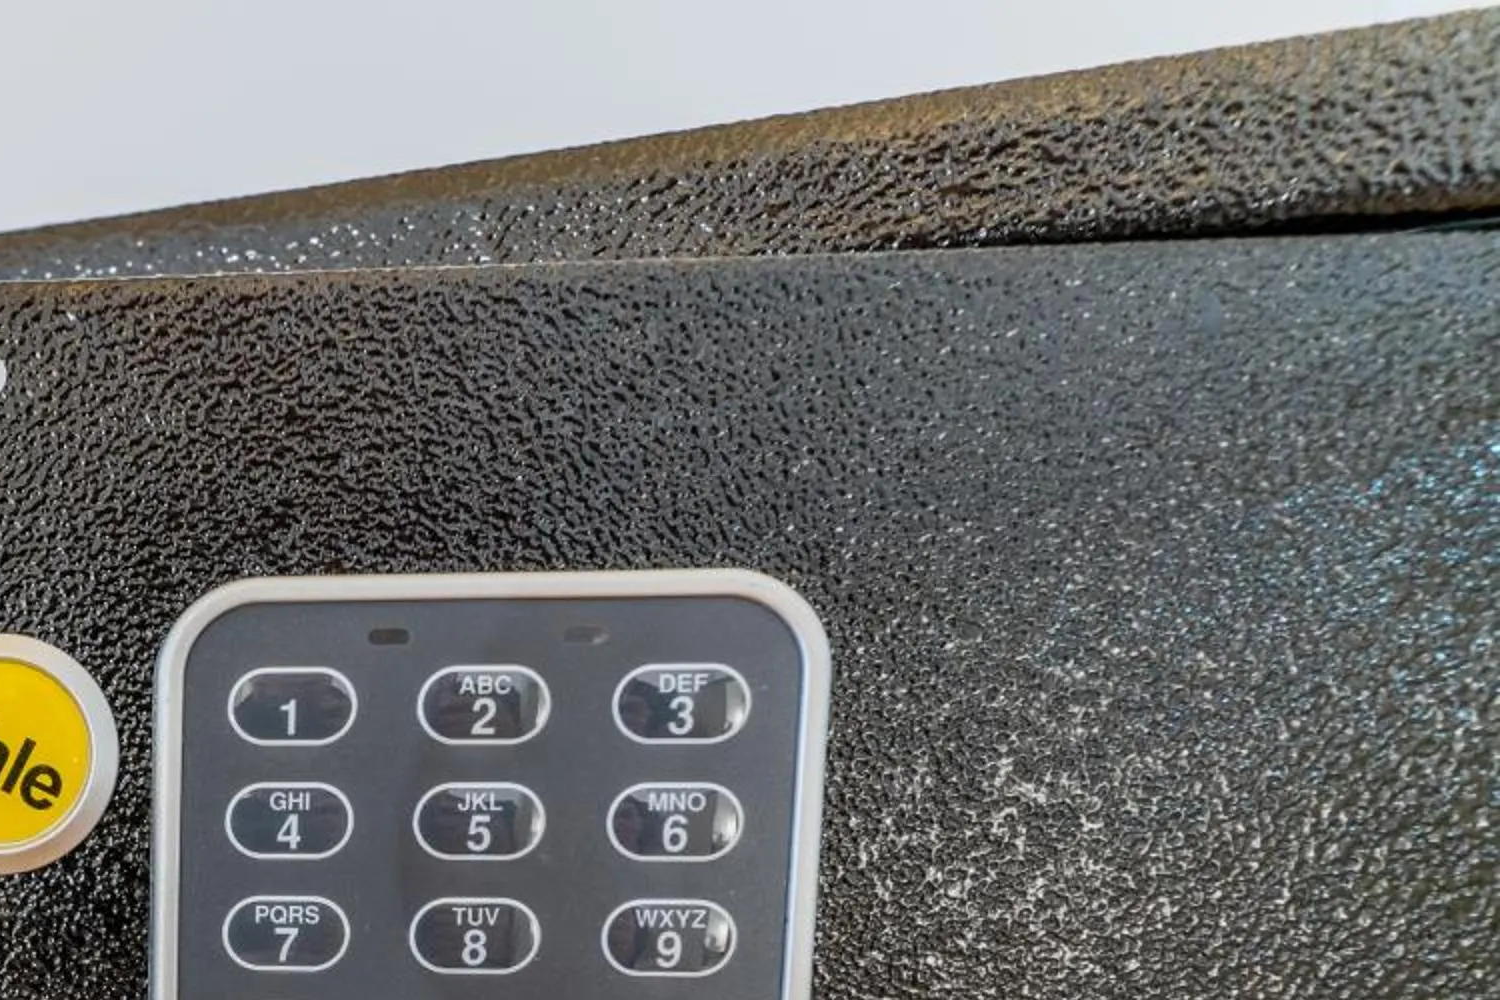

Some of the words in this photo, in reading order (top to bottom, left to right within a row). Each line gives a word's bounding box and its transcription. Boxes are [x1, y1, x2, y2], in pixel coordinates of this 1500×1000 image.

[458, 673, 512, 696] ABC
[658, 673, 710, 695] DEF
[278, 698, 298, 736] 1
[470, 698, 497, 736] 2
[666, 697, 695, 736] 3
[268, 791, 312, 812] GHI
[456, 791, 504, 813] JKL
[647, 791, 707, 814] MNO
[275, 812, 301, 850] 4
[466, 814, 492, 852] 5
[661, 814, 688, 853] 6
[254, 905, 321, 927] PQRS
[451, 907, 501, 928] TUV
[635, 908, 708, 929] WXYZ
[273, 926, 299, 963] 7
[461, 928, 488, 966] 8
[656, 930, 683, 970] 9
